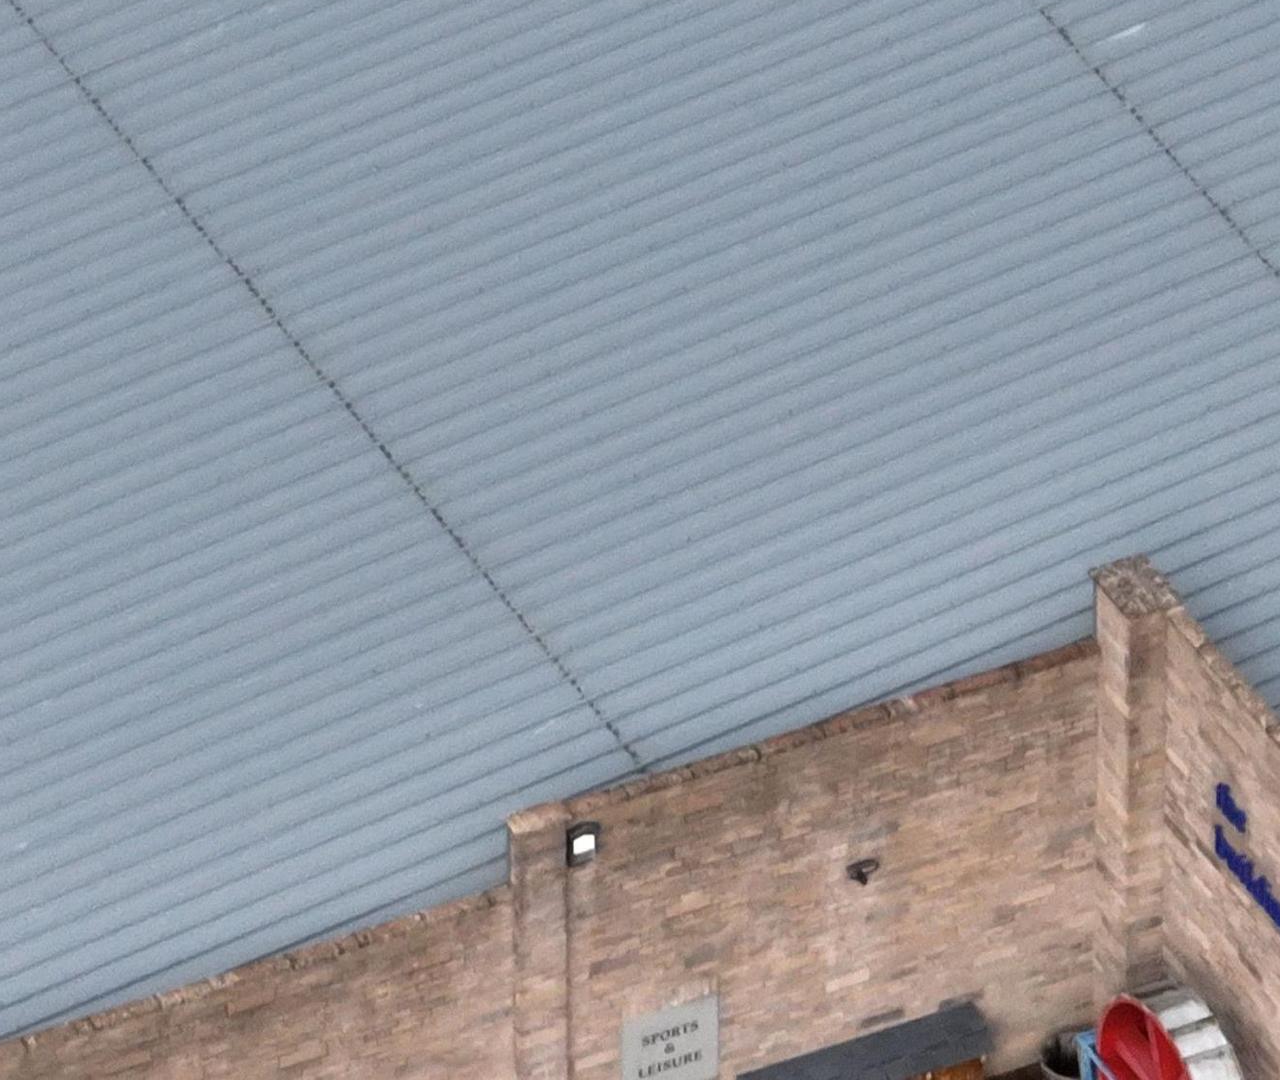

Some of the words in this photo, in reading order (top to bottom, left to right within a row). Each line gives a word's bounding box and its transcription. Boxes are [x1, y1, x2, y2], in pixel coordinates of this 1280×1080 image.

[642, 1020, 698, 1047] SPORTS
[664, 1042, 675, 1054] &
[639, 1050, 702, 1078] LEISURE
